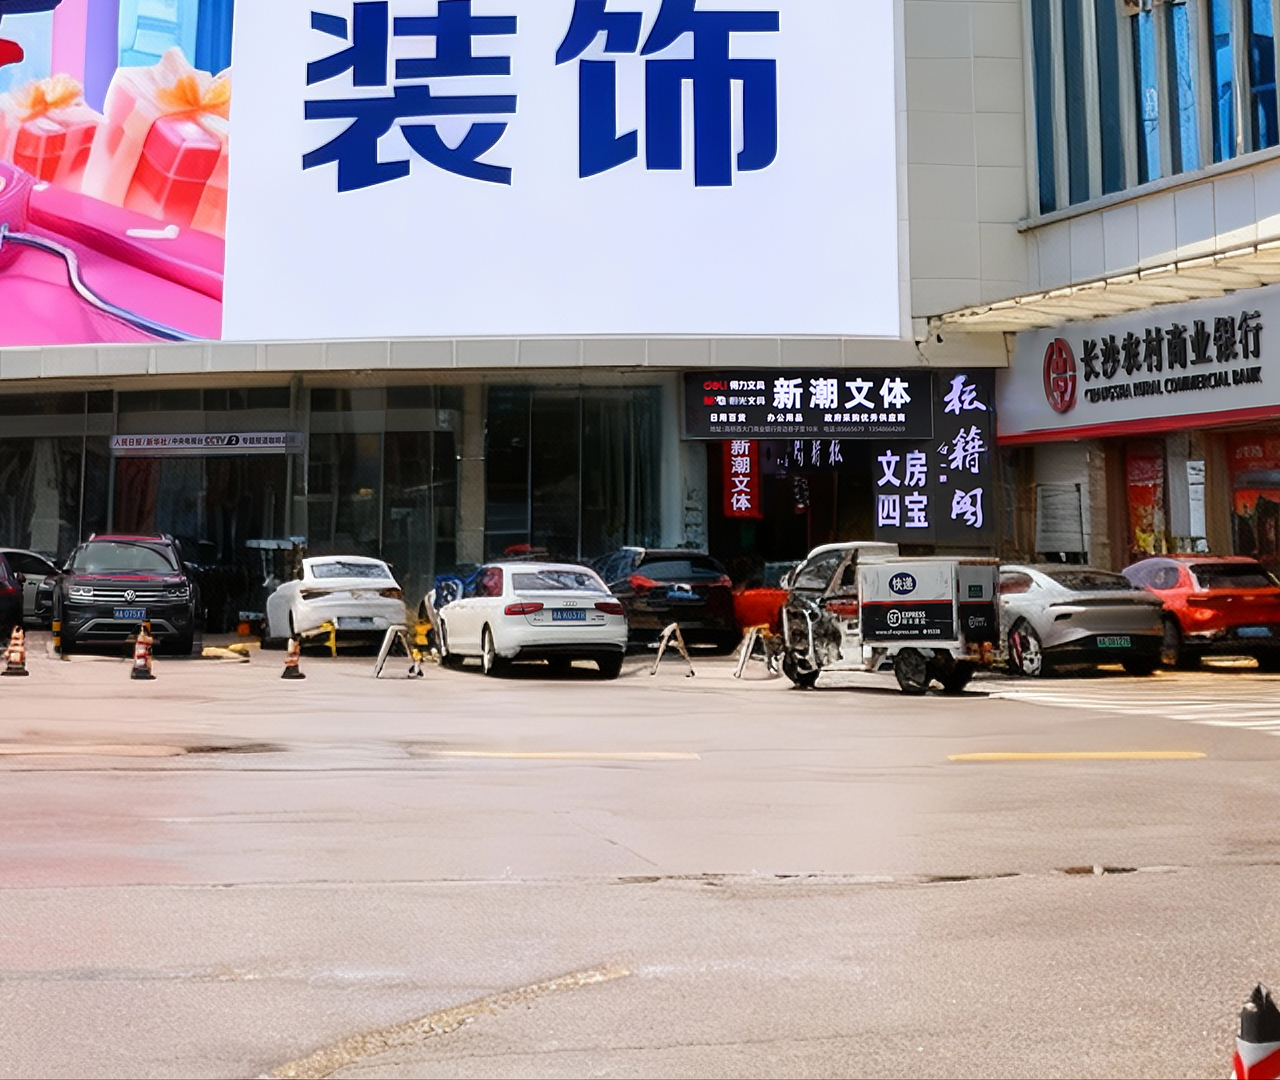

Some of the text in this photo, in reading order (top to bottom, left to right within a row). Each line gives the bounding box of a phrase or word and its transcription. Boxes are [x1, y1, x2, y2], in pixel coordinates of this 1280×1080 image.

[1080, 310, 1264, 382] 长沙农村商业银行
[772, 377, 912, 410] 新潮文体
[710, 413, 747, 423] 日用百货
[766, 413, 803, 423] 办公用品
[730, 439, 752, 511] 新潮文体
[876, 449, 928, 488] 文房
[877, 491, 929, 528] 四宝
[892, 576, 914, 591] 快递
